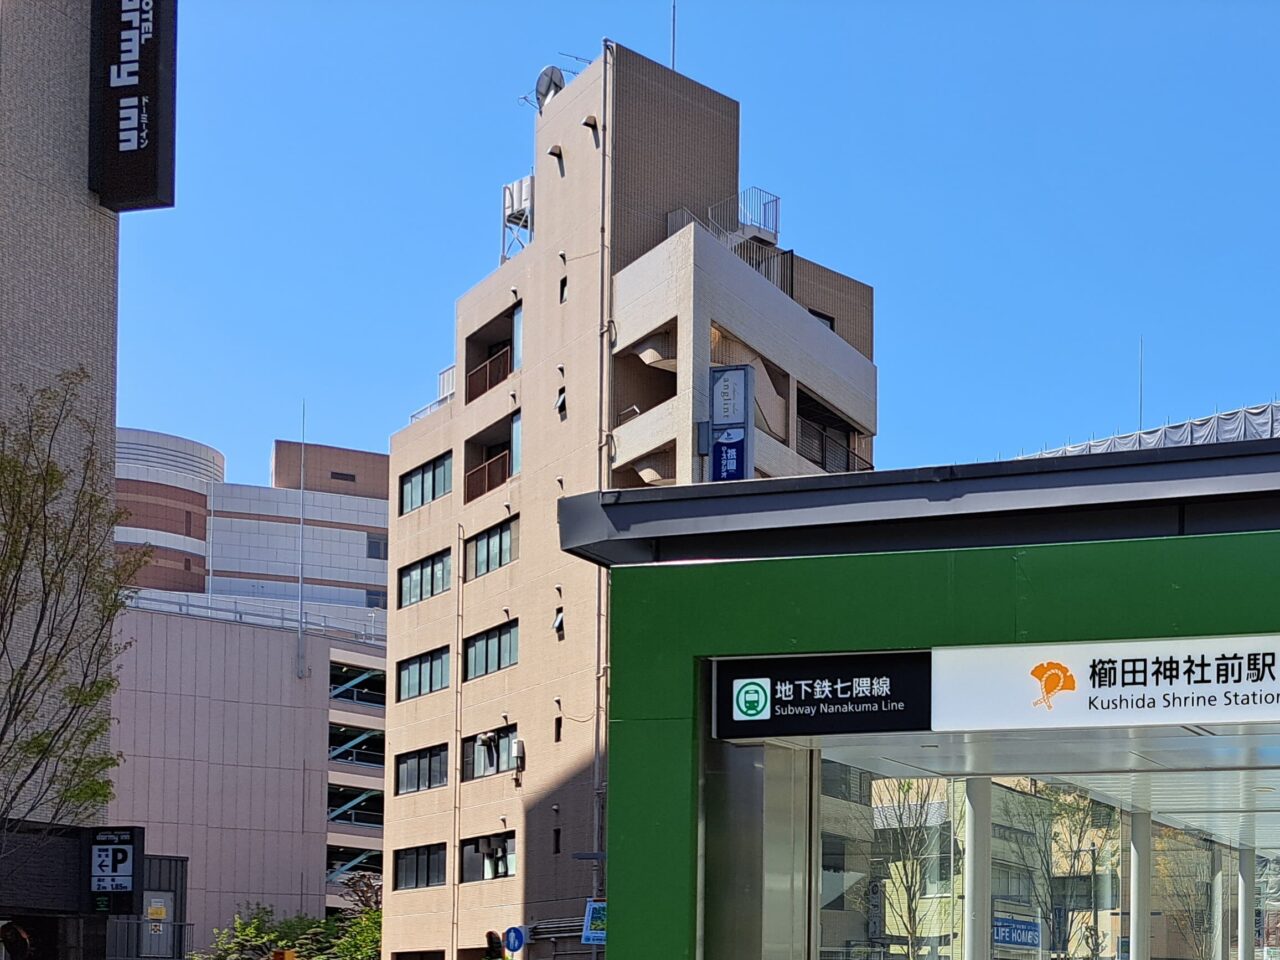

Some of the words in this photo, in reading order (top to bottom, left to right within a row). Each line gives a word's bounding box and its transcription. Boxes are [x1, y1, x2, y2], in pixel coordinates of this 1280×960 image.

[119, 97, 139, 151] inn
[1089, 652, 1276, 689] 櫛田神社前駅
[775, 676, 891, 701] 地下鉄七隈線
[1088, 692, 1156, 711] Kushida
[1163, 691, 1217, 708] Shrine
[775, 704, 816, 716] Subway
[820, 701, 878, 713] Nanakuma
[882, 700, 904, 711] Line
[111, 848, 128, 873] P
